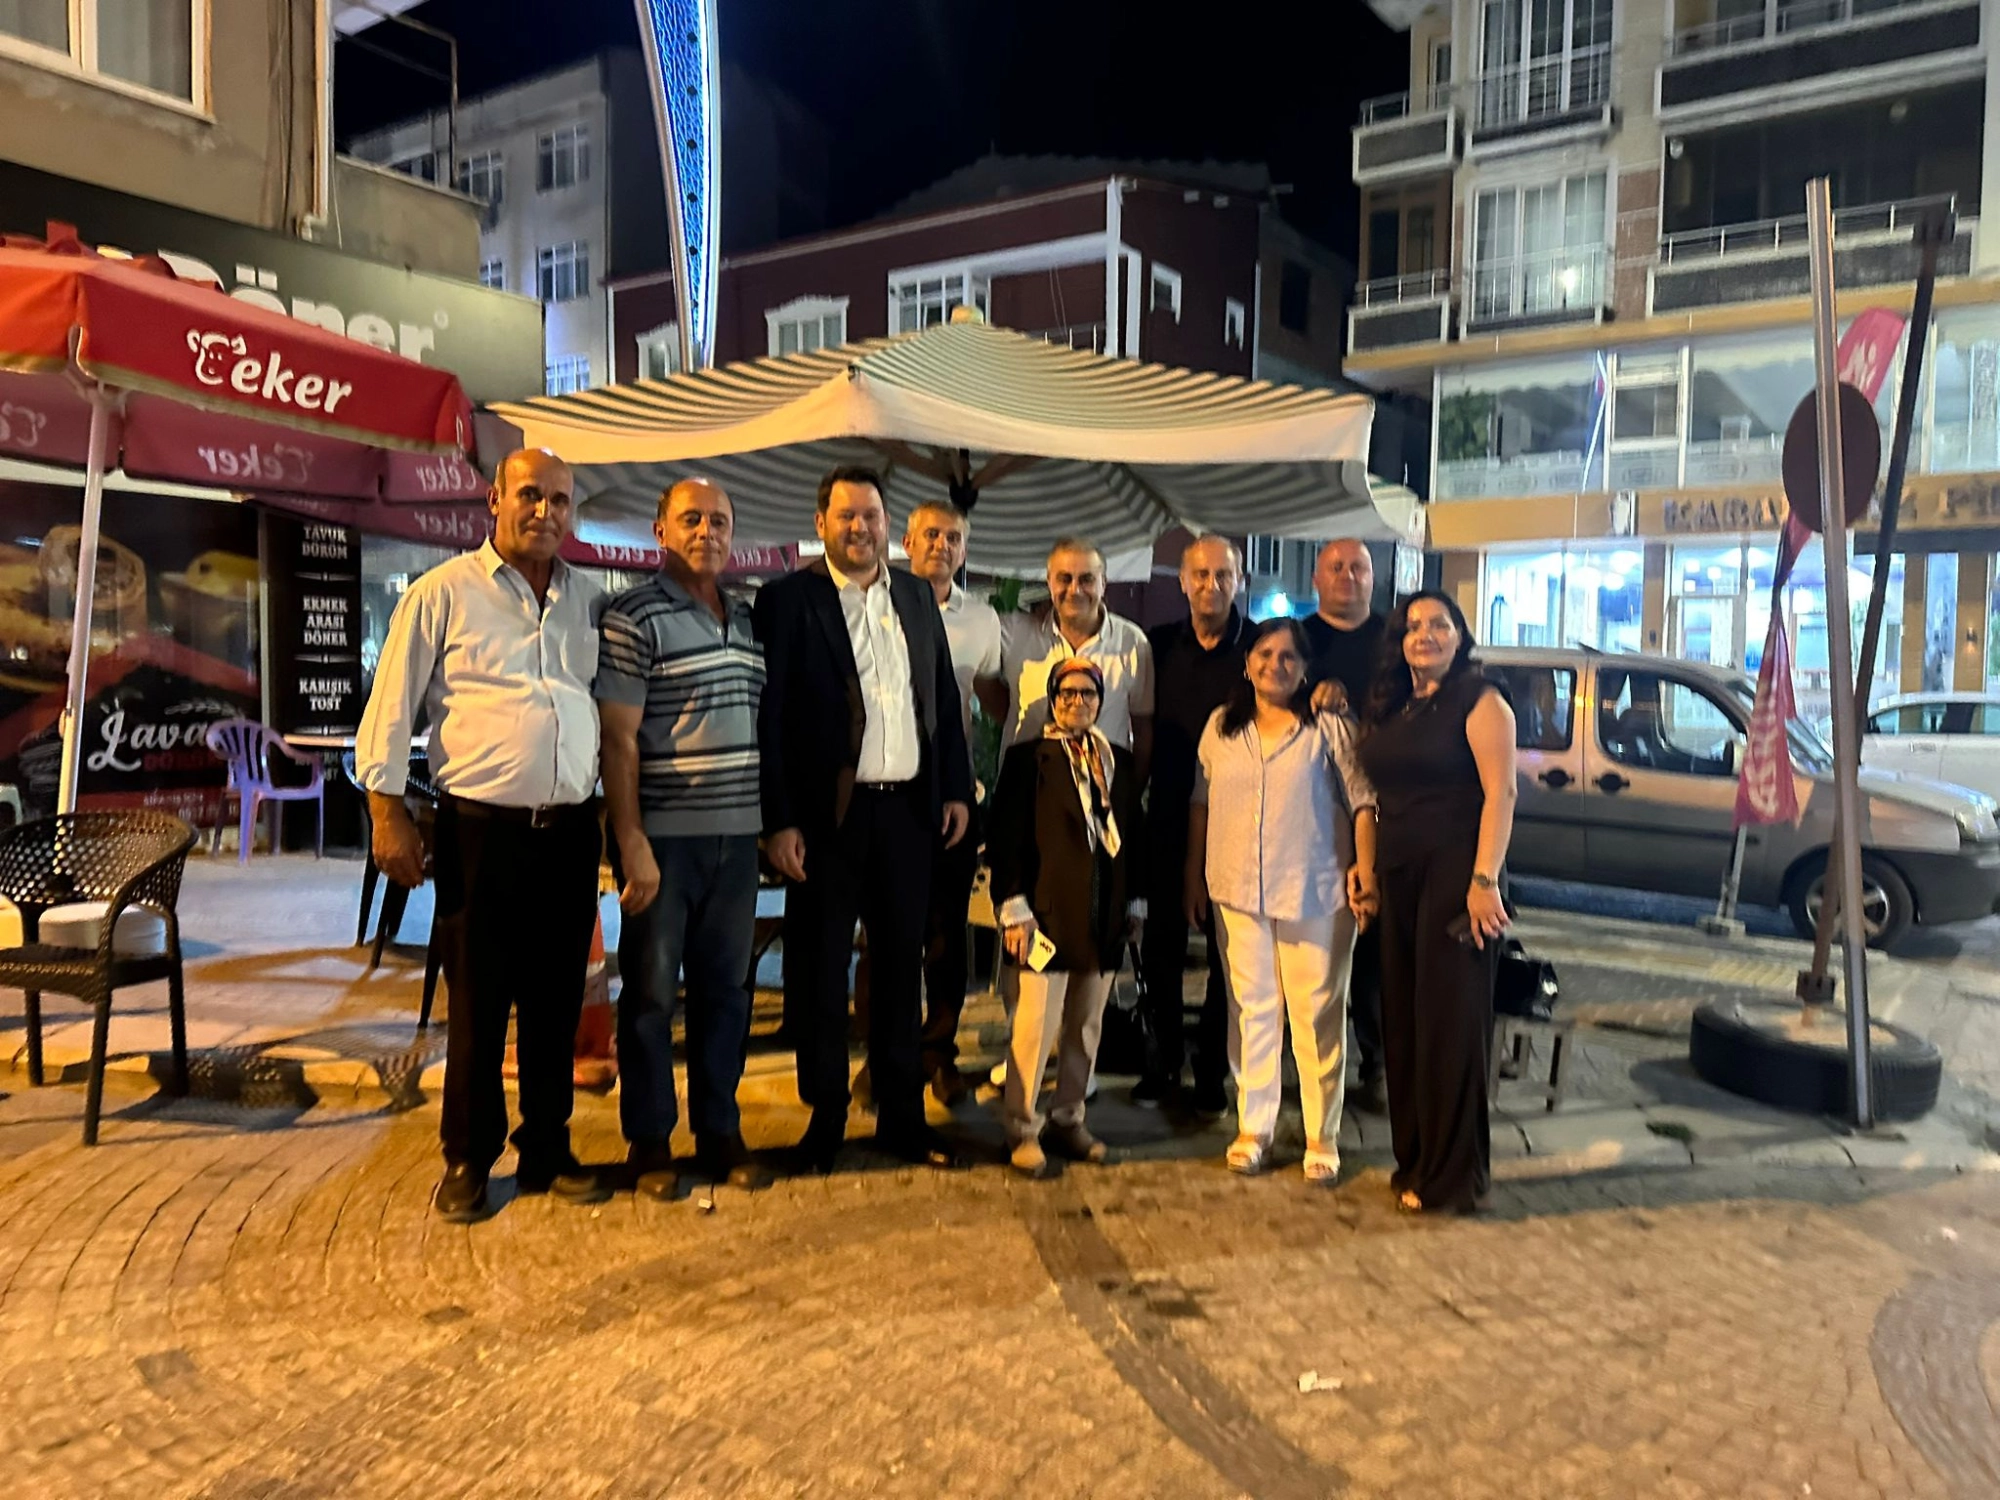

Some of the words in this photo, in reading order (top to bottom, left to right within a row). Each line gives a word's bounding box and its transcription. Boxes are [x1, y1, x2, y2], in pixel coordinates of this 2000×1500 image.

[303, 525, 347, 542] TAVUK
[303, 595, 348, 613] EKMEK
[306, 613, 344, 629] ARASI
[304, 629, 347, 646] DÖNER
[299, 677, 352, 695] KARIŞIK
[310, 695, 341, 711] TOST
[86, 707, 209, 772] Lava
